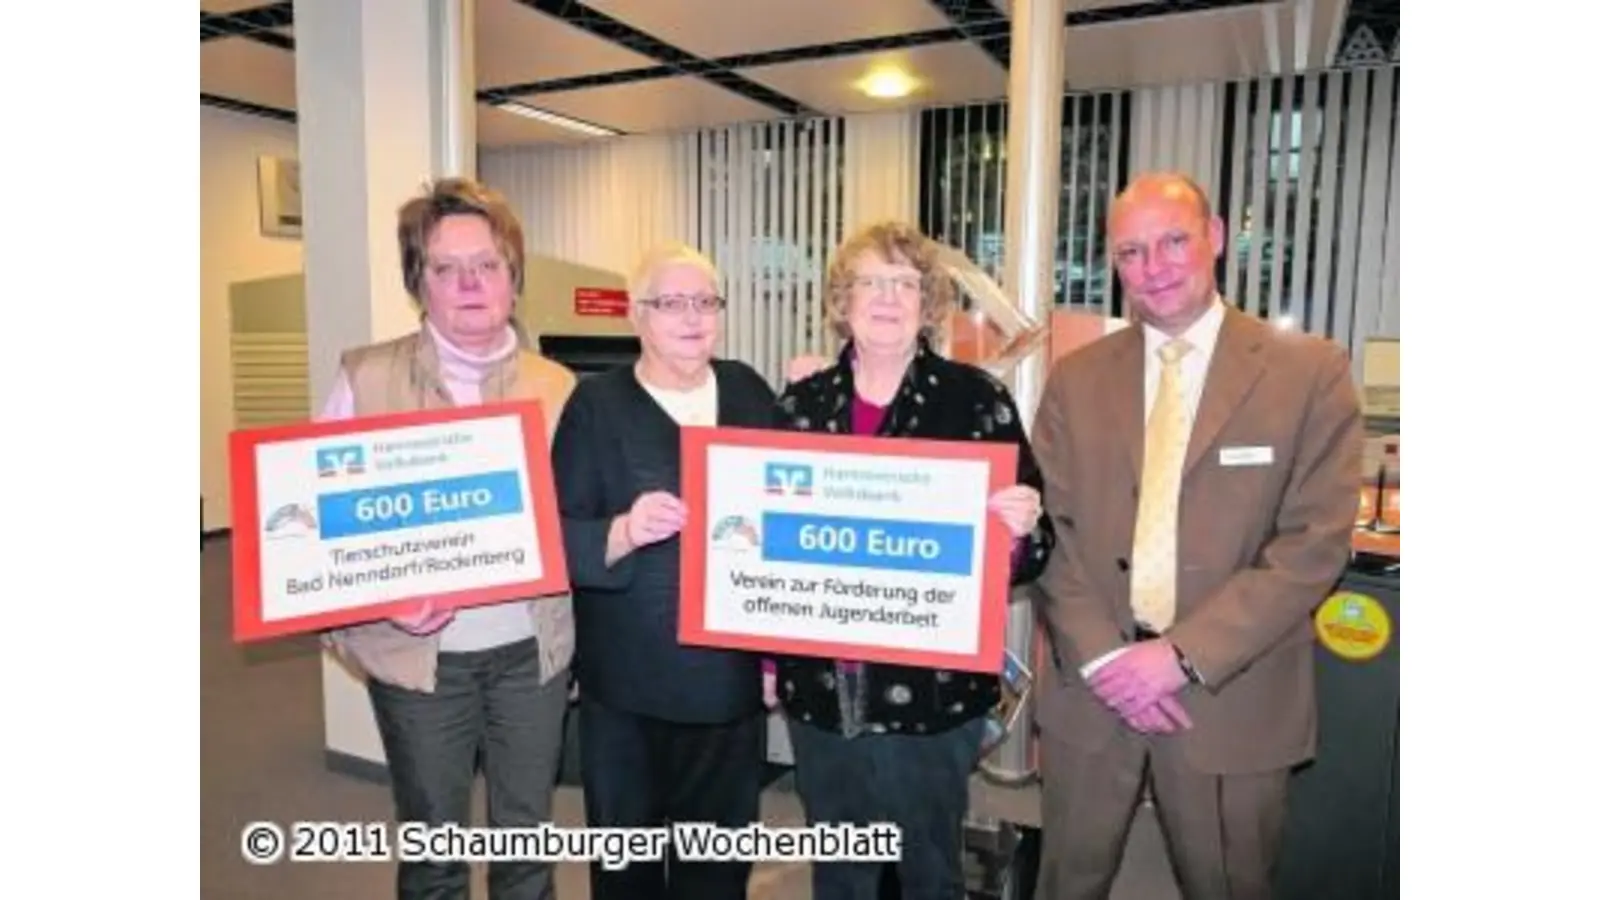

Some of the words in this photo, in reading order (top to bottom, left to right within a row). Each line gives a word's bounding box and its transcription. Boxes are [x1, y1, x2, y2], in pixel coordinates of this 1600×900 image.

[355, 493, 413, 521] 600
[423, 487, 492, 514] Euro
[329, 532, 475, 565] Tierschutzverein
[799, 524, 856, 552] 600
[867, 529, 940, 559] Euro
[286, 572, 323, 595] Bad
[730, 570, 786, 592] Verein
[790, 575, 816, 593] zur
[824, 577, 918, 605] Förderung
[924, 586, 956, 604] der
[742, 598, 814, 618] offenen
[818, 605, 939, 628] Jugendarbeit
